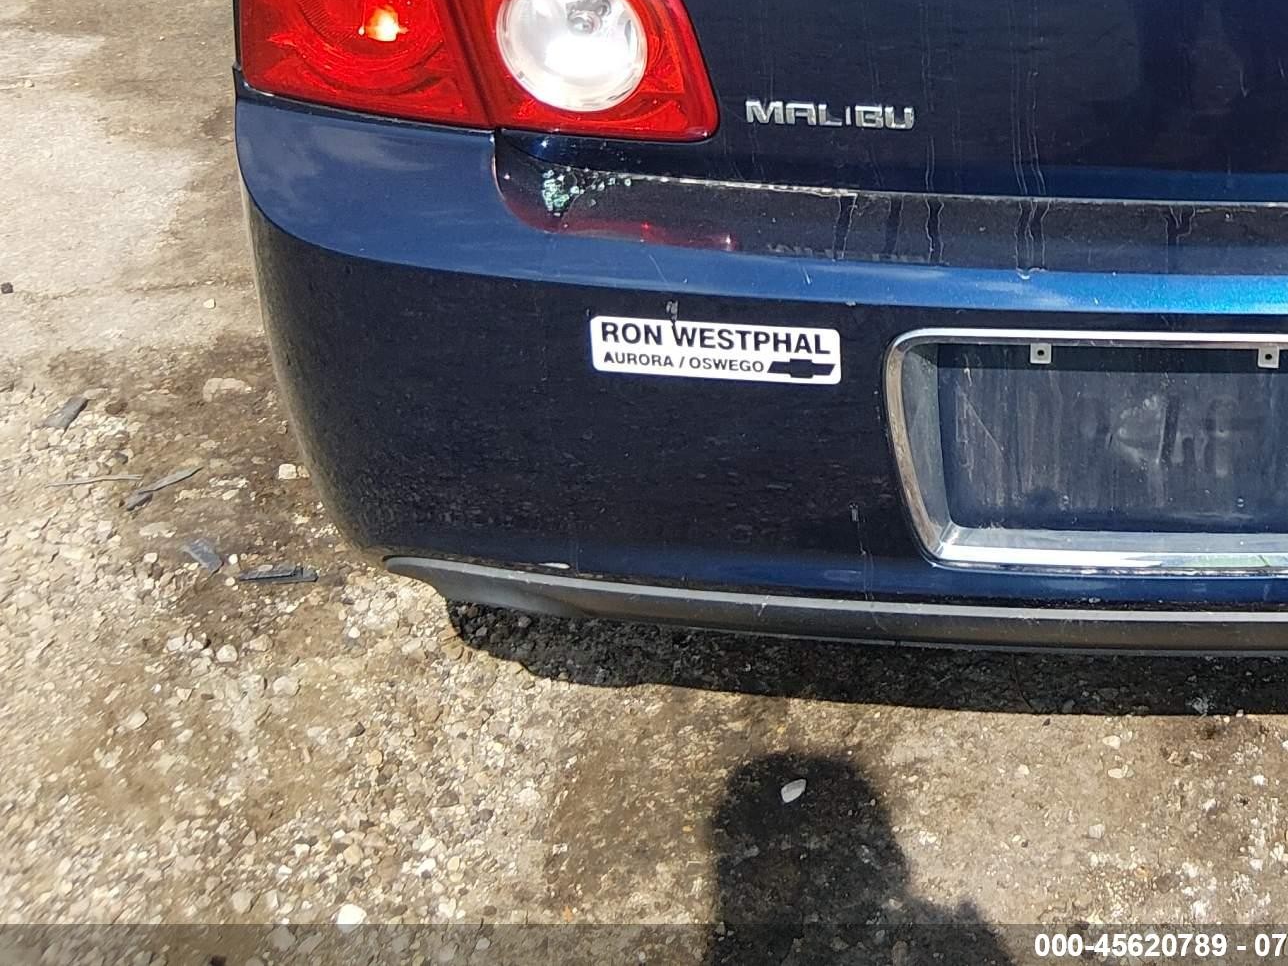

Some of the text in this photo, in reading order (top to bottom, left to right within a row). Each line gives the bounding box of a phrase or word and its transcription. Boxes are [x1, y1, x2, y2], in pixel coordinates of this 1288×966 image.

[745, 100, 915, 129] MALIBU
[601, 322, 831, 355] RON WESTPHAL
[603, 351, 674, 368] AURORA
[689, 356, 764, 373] OSWEGO
